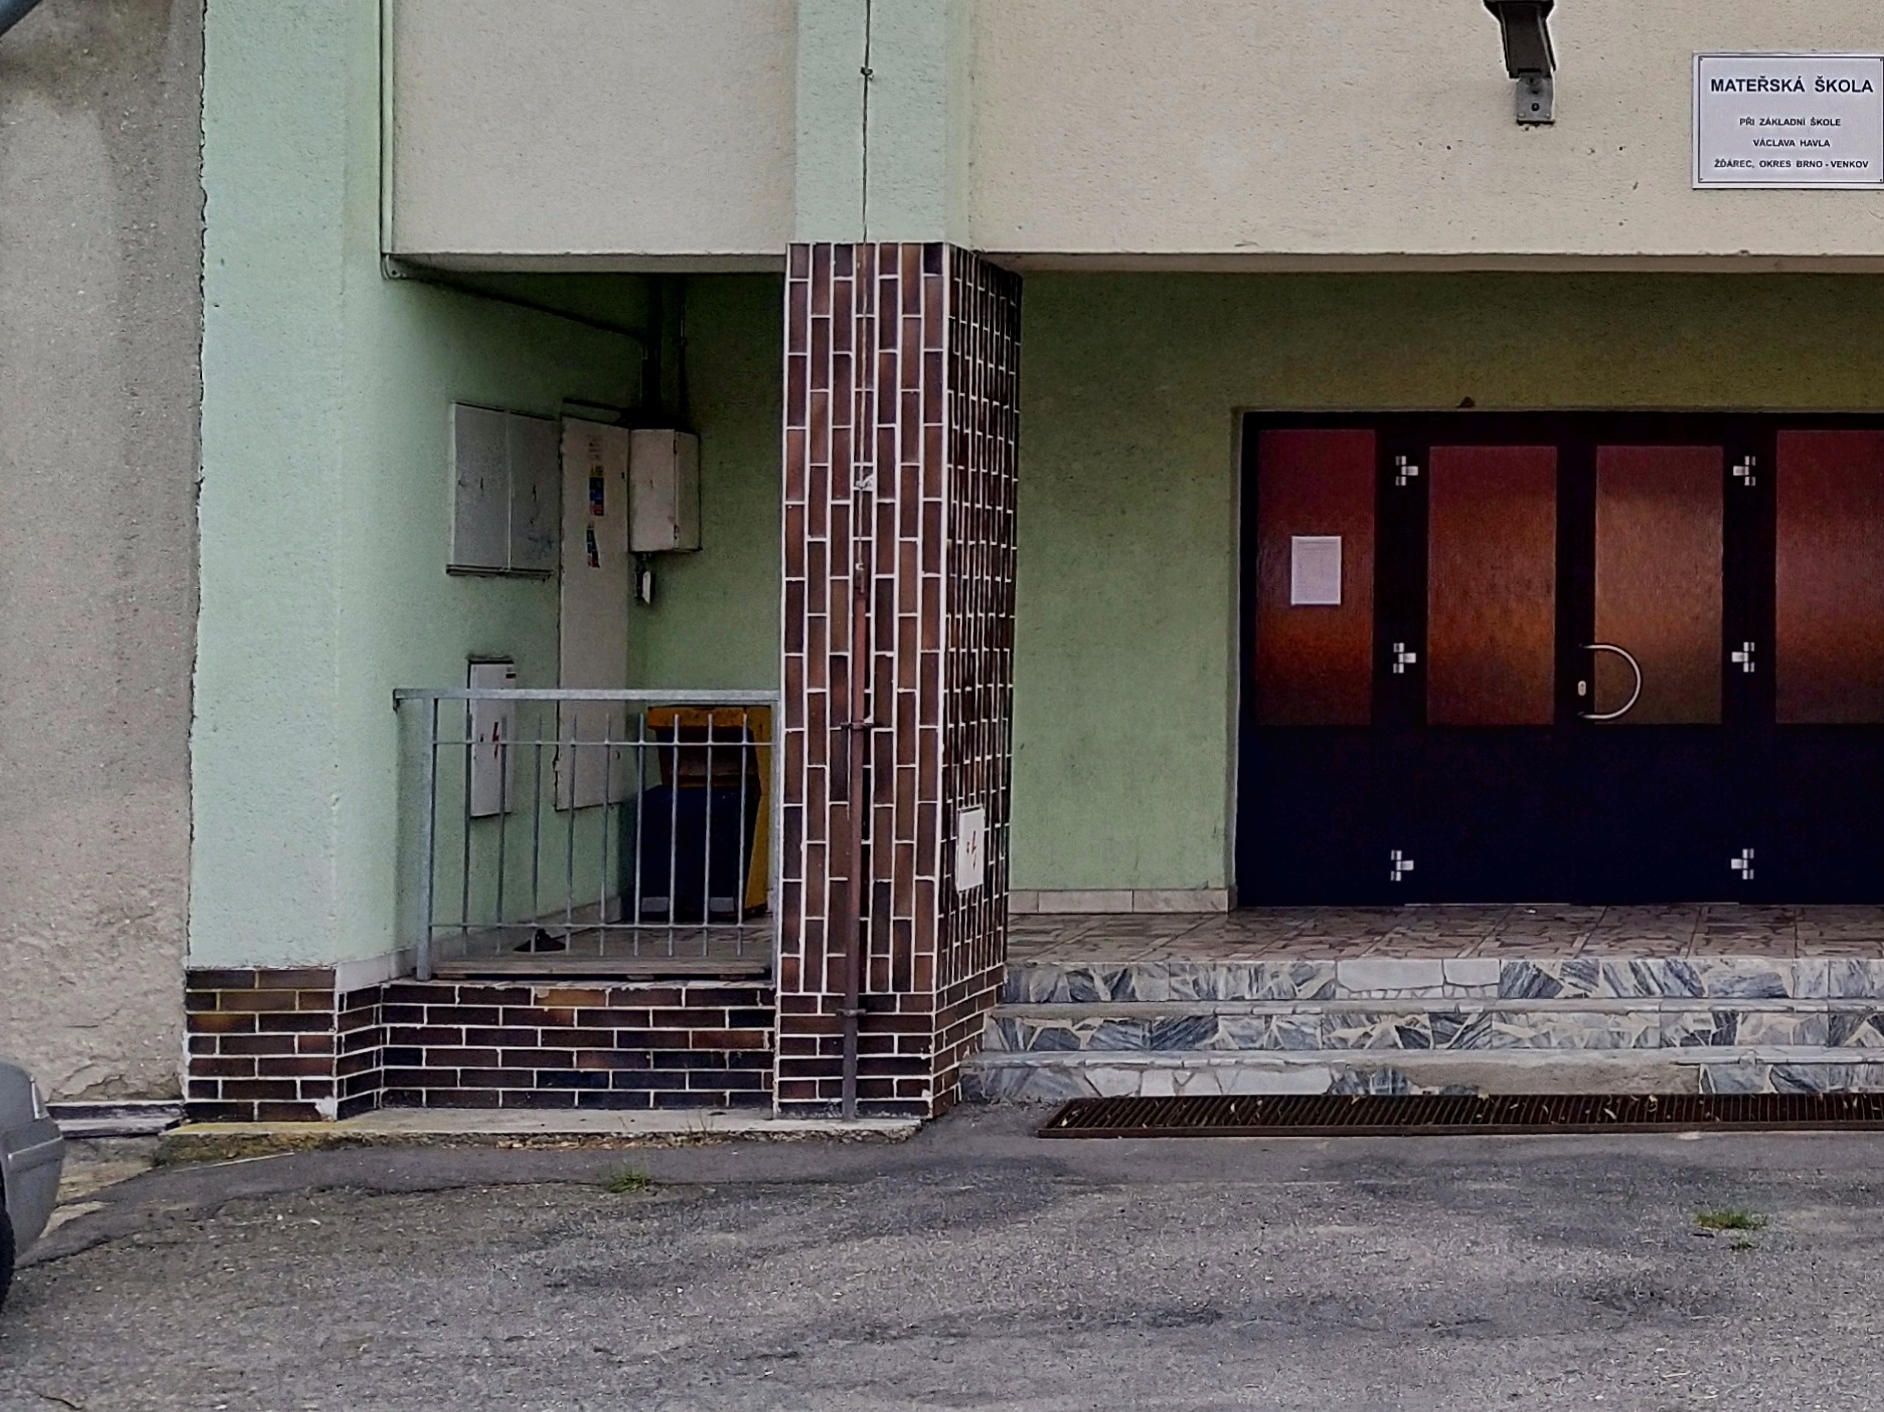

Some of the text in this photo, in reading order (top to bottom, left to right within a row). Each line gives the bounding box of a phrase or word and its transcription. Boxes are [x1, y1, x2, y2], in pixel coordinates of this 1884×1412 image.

[1710, 75, 1874, 93] MATEŘSKÁ ŠKOLA
[1739, 116, 1842, 126] PŘI ZÁKLADNÍ ŠKOLE
[1752, 137, 1831, 147] VÁCLAVA HAVLA
[1713, 157, 1755, 169] ŽĎÁREC,
[1758, 159, 1792, 168] OKRES
